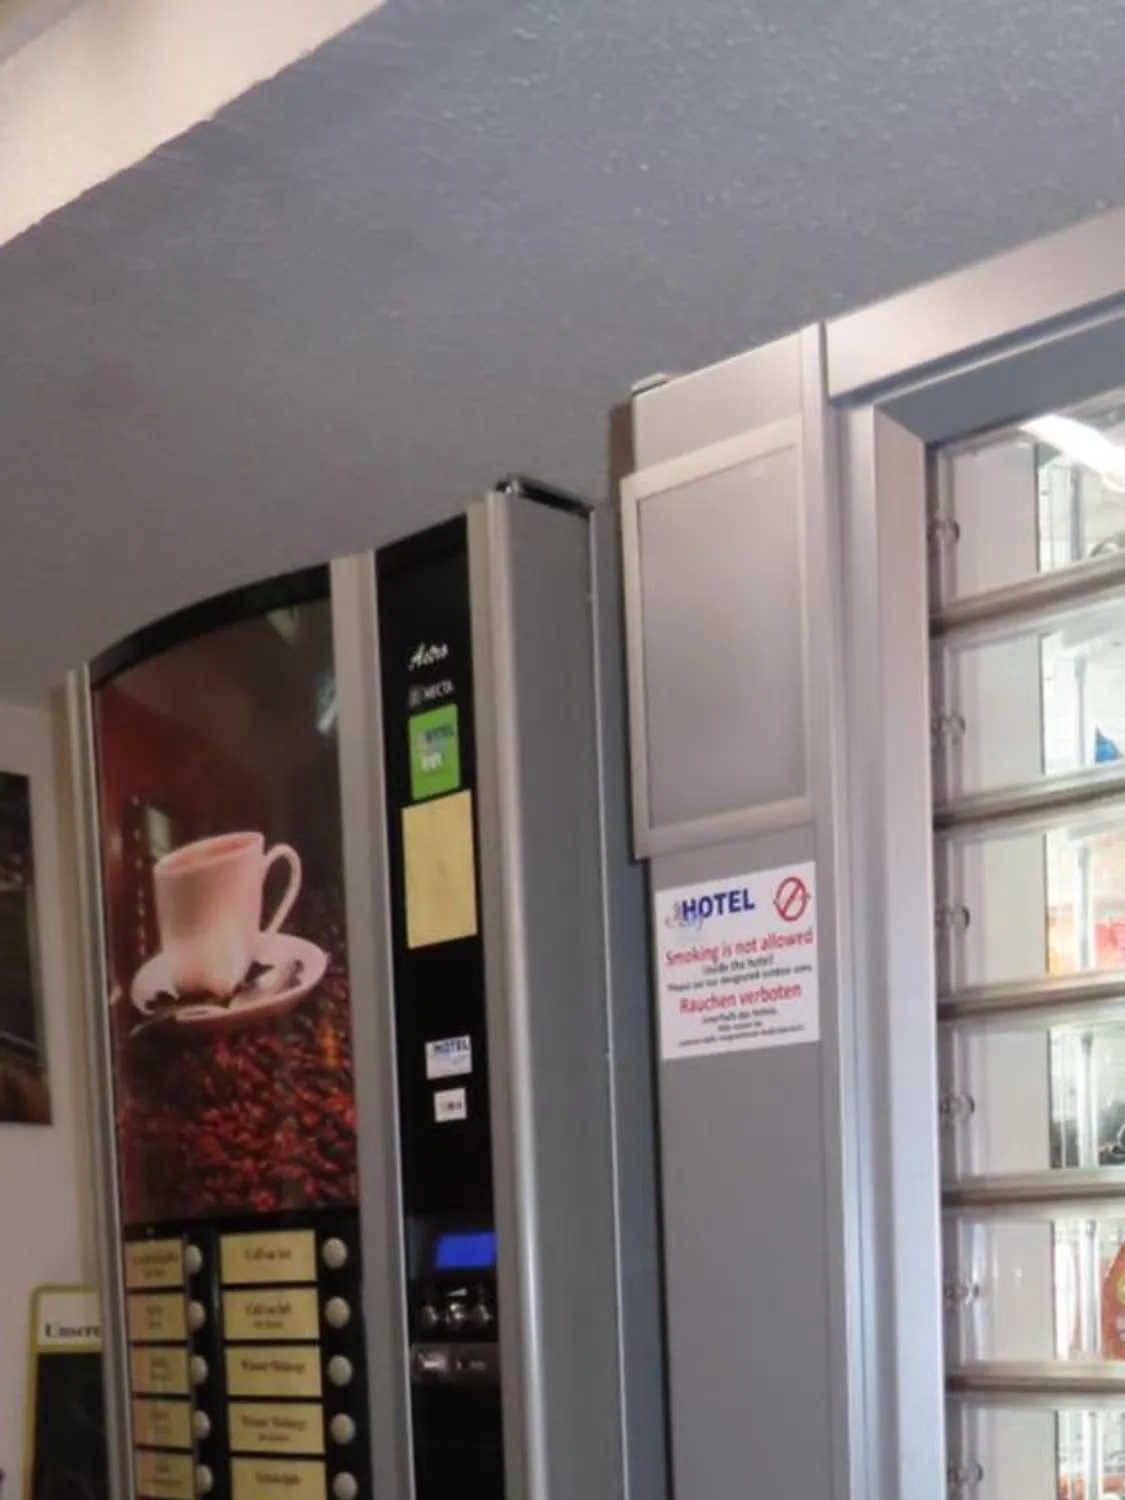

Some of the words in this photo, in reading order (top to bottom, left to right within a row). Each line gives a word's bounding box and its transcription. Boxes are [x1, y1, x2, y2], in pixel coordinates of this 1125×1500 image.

[682, 888, 756, 921] HOTEL
[665, 945, 720, 965] Smoking
[735, 937, 758, 954] not
[761, 926, 813, 950] allowed
[680, 993, 736, 1013] Rauchen
[739, 985, 802, 1005] verboten
